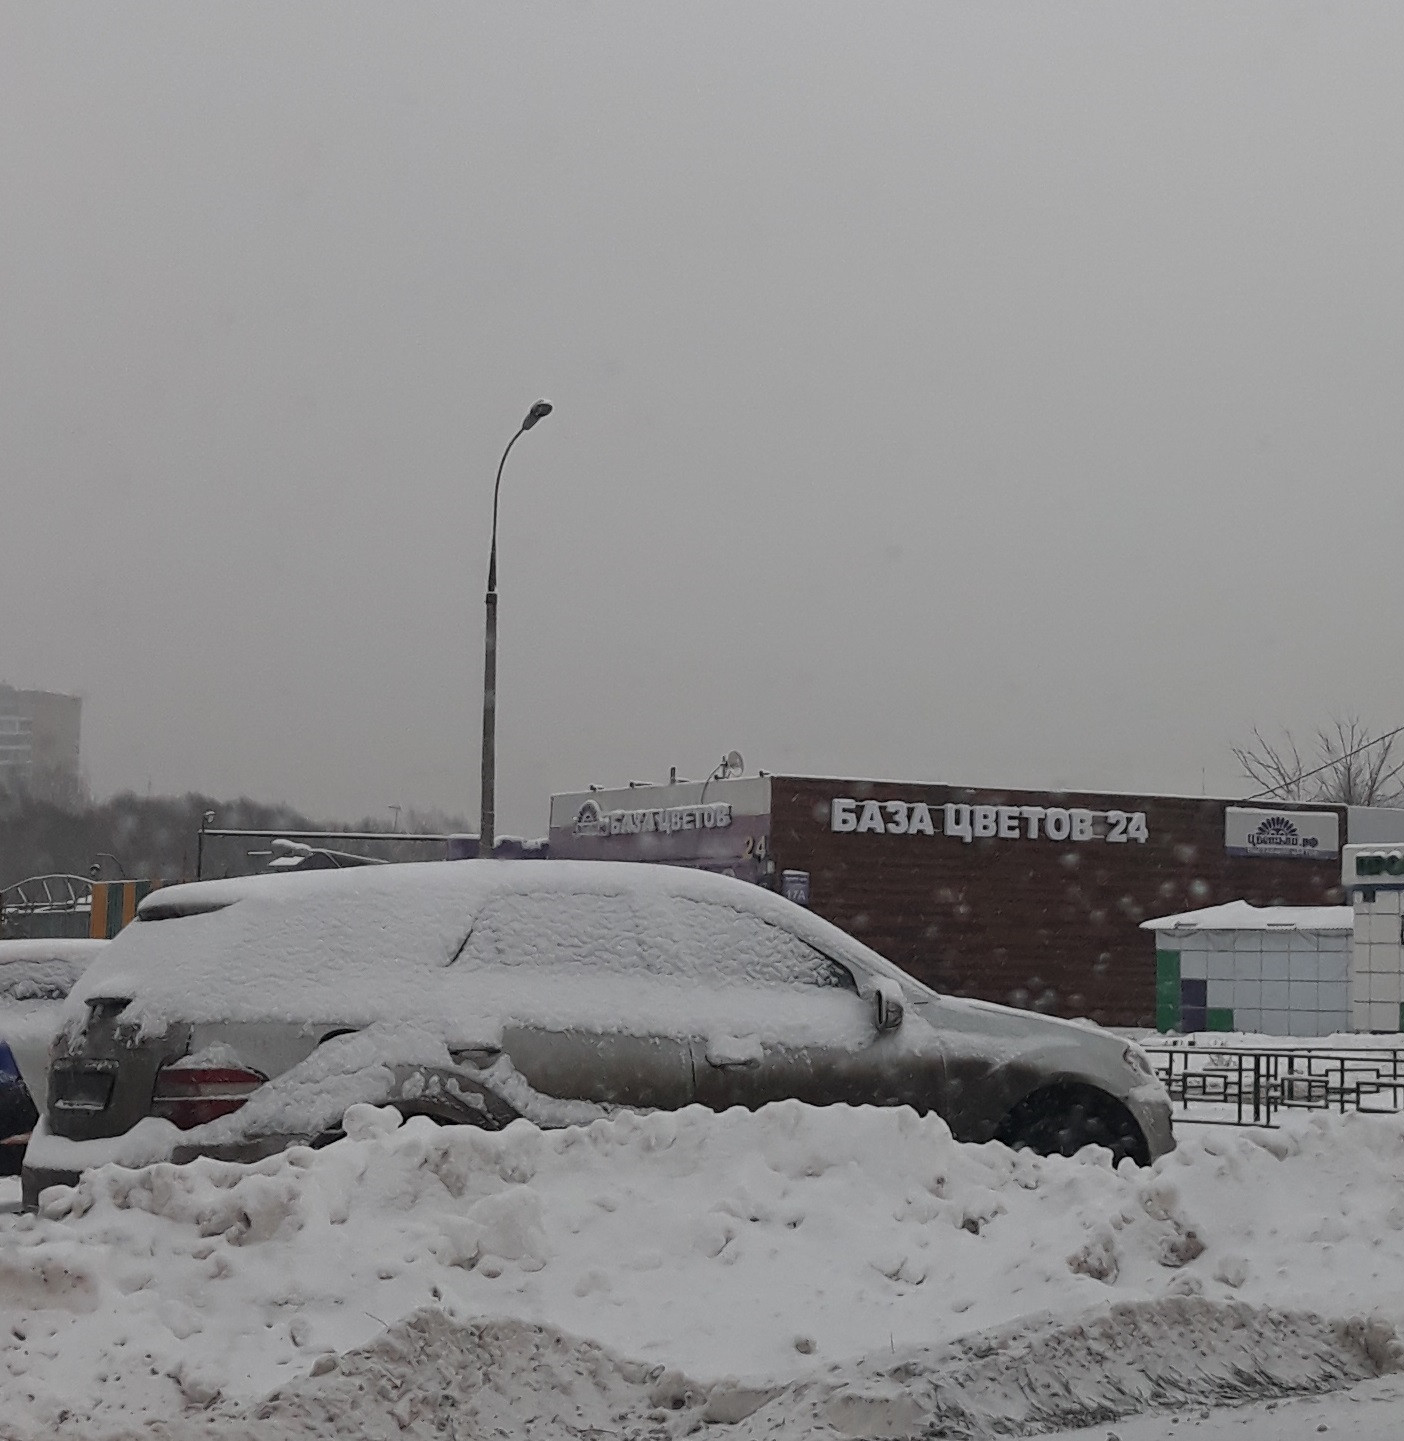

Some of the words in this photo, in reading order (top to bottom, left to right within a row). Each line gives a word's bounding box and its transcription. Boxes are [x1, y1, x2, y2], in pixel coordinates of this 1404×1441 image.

[610, 809, 656, 835] БАЗА
[658, 803, 732, 834] ЦВЕТОВ
[832, 798, 934, 835] БАЗА
[944, 804, 1095, 844] ЦВЕТОВ
[1106, 811, 1149, 844] 24
[744, 836, 767, 860] 24
